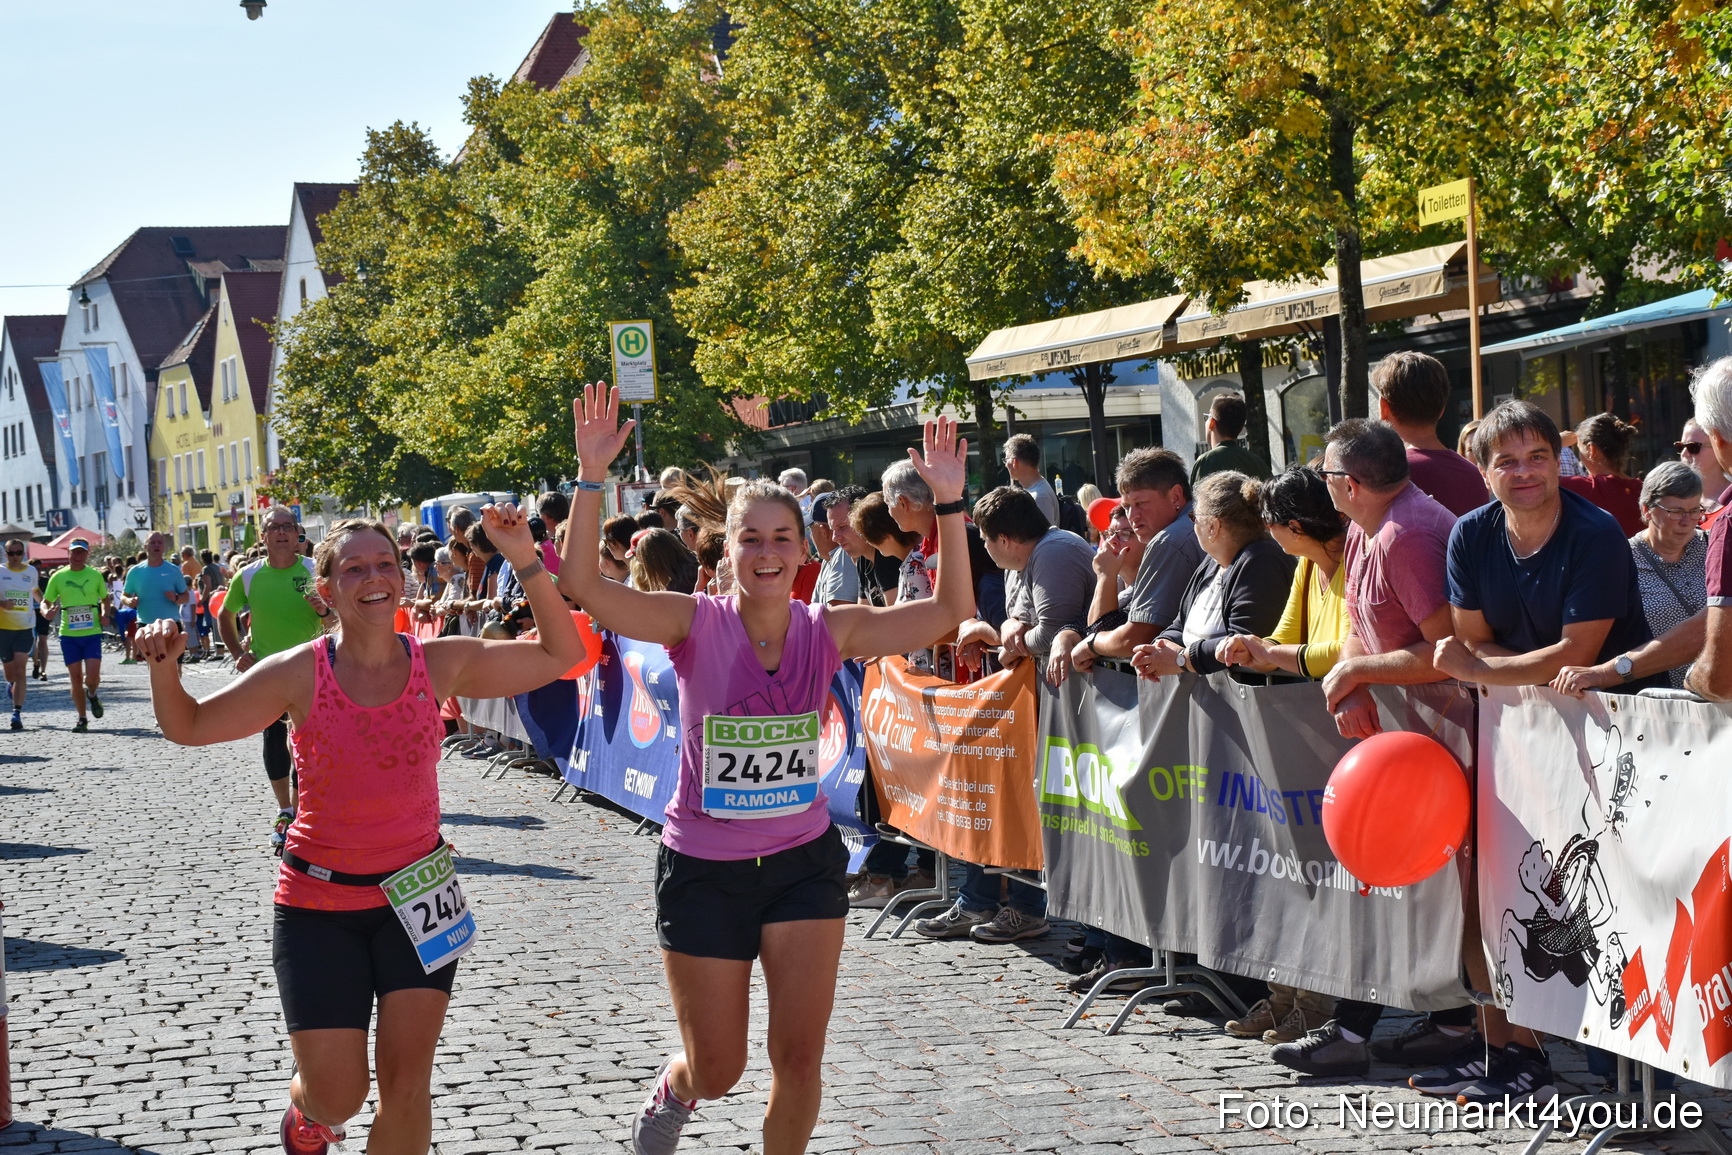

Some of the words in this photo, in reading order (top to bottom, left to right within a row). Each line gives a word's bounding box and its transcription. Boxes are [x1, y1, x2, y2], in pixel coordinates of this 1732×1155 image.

[1427, 192, 1467, 213] Toiletten
[625, 333, 640, 351] H
[70, 613, 91, 622] 2419
[977, 687, 1005, 700] Partner
[713, 718, 811, 744] BOCK
[890, 723, 917, 754] CLINIC
[950, 725, 963, 736] was
[965, 724, 1002, 740] Internet,
[949, 742, 983, 760] Werbung
[985, 744, 1018, 761] angeht.
[718, 749, 806, 784] 2424
[624, 767, 638, 793] GET
[964, 778, 977, 793] bei
[978, 782, 996, 794] uns:
[724, 790, 800, 807] RAMONA
[974, 817, 993, 832] 897
[1039, 808, 1090, 836] inspired
[394, 851, 454, 901] BOCK
[446, 923, 470, 948] NINA
